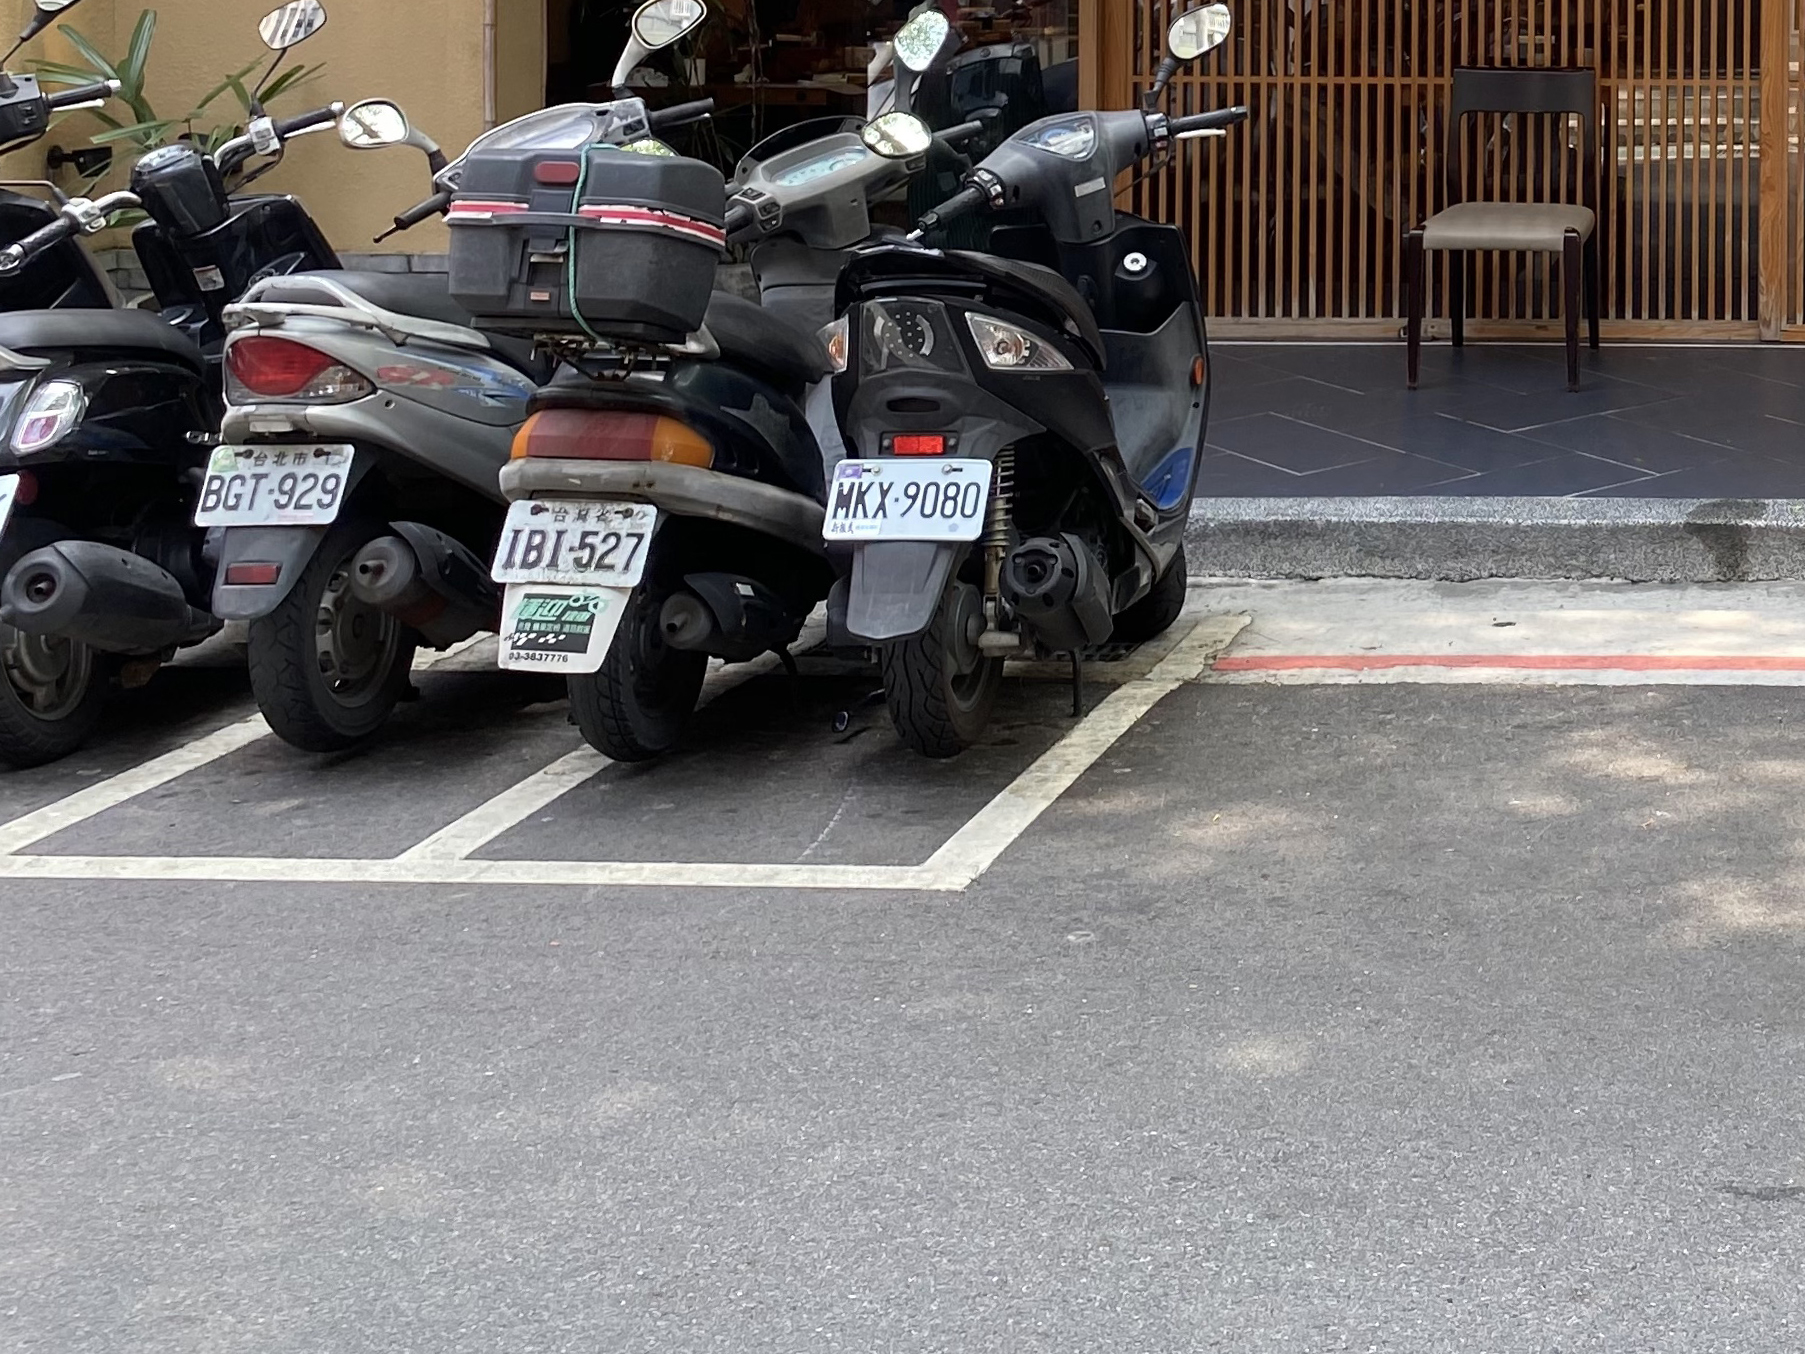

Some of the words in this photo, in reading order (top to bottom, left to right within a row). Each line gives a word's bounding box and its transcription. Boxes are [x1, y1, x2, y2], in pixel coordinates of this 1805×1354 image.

[253, 450, 309, 467] 台北市
[201, 472, 342, 512] BGT-929
[832, 481, 981, 519] MKX-9080
[501, 529, 646, 573] IBI-527
